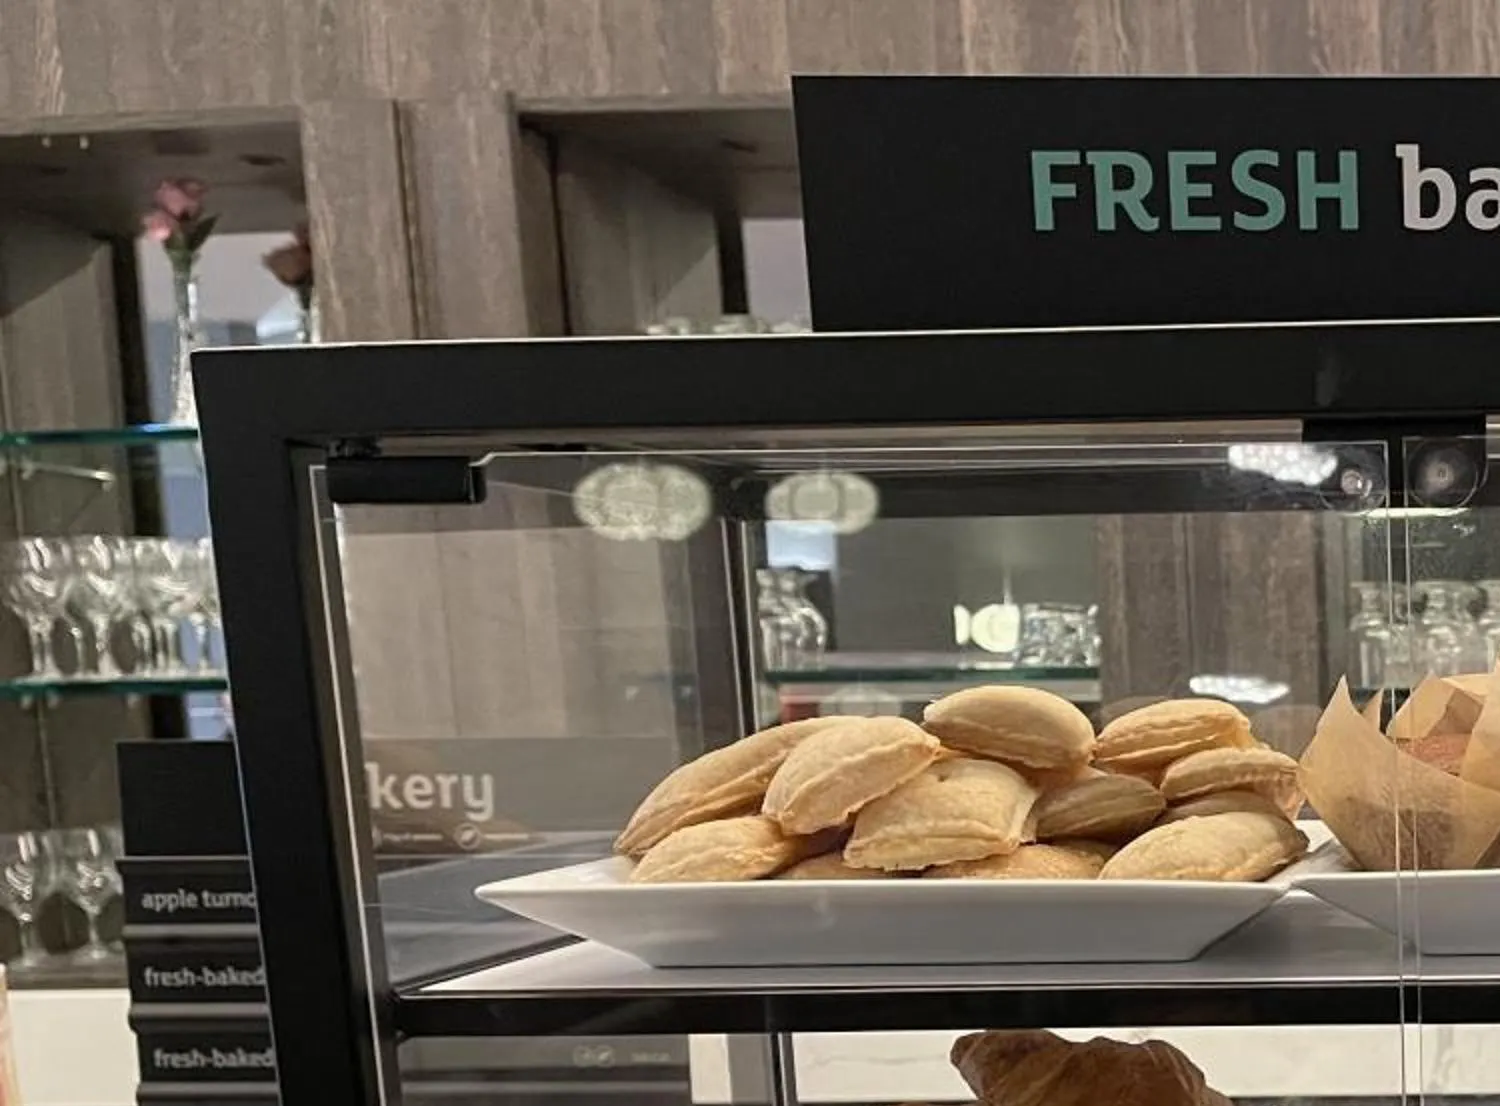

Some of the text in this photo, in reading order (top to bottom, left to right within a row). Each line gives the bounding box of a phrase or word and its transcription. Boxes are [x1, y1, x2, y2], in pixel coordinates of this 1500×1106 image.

[1029, 149, 1361, 232] FRESH
[364, 761, 494, 822] kery
[141, 888, 257, 913] apple turno
[144, 966, 267, 988] fresh-baked
[153, 1047, 276, 1069] fresh-baked
